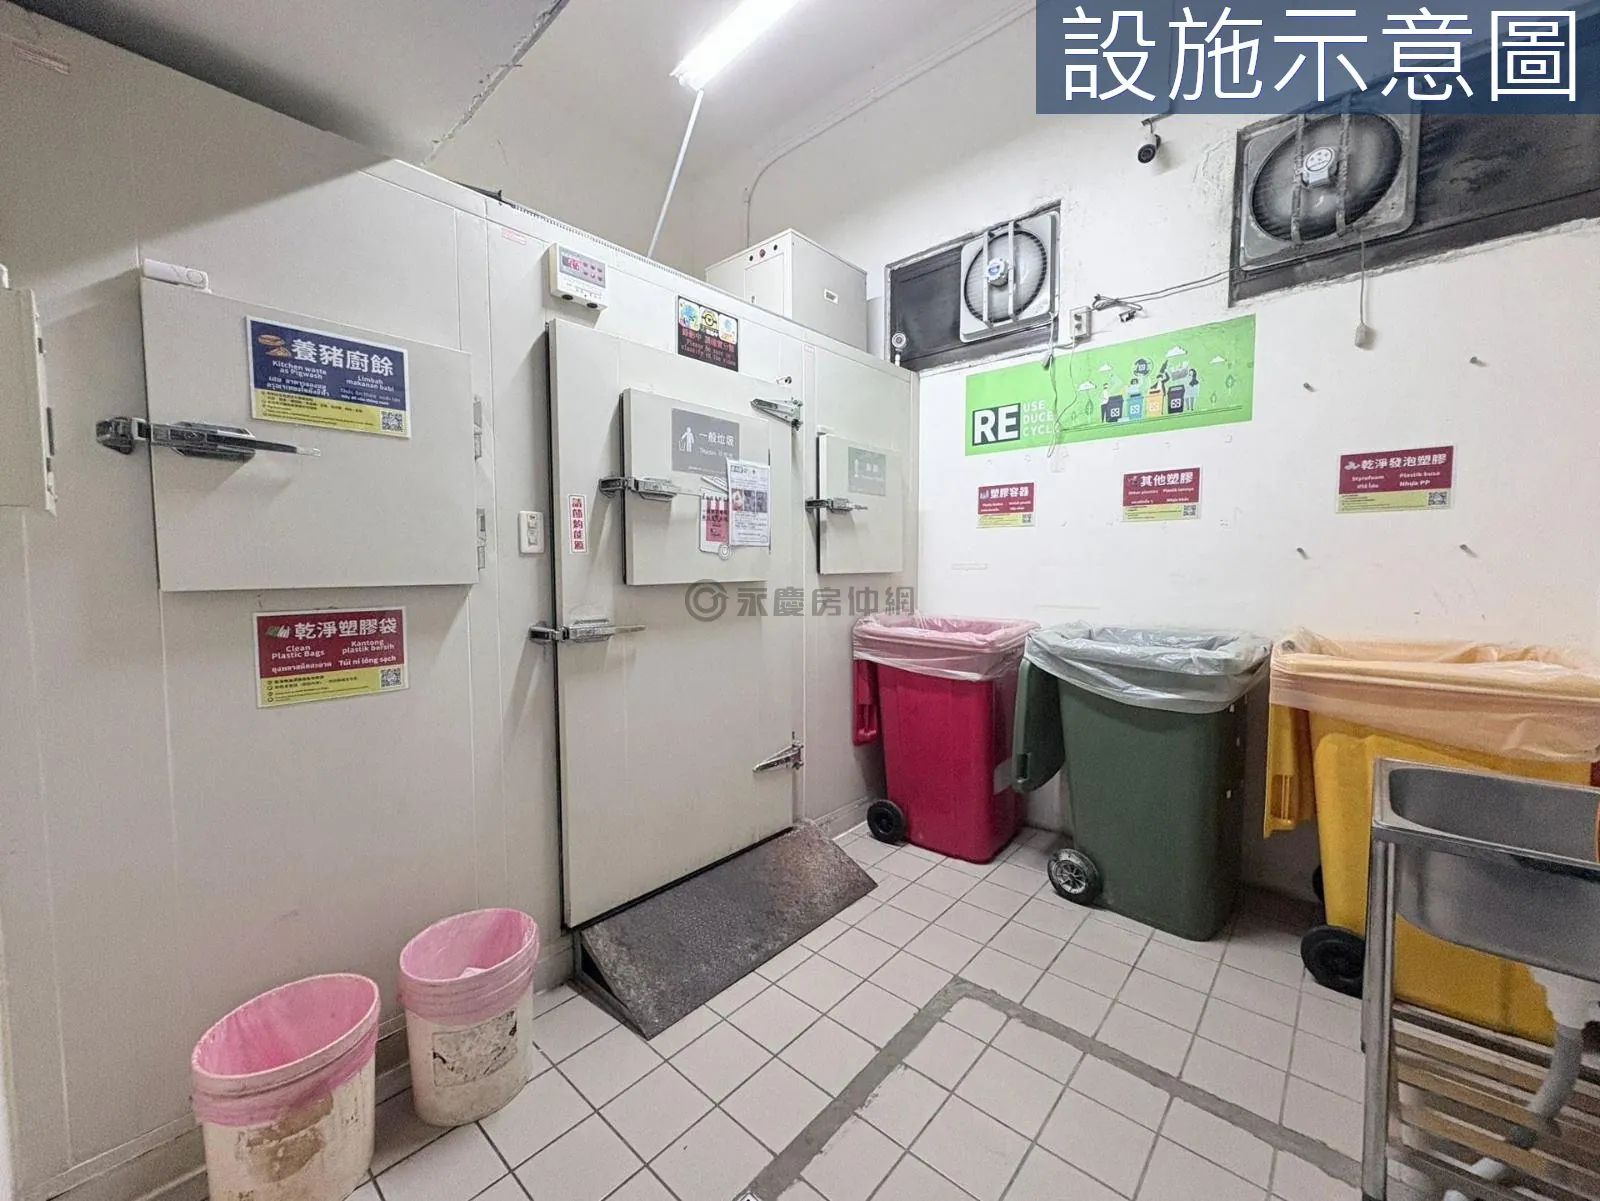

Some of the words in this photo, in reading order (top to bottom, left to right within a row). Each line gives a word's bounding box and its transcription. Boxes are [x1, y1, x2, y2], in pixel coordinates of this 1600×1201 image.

[291, 338, 394, 377] 養豬廚餘
[272, 360, 304, 371] Kitchen
[304, 366, 327, 375] waste
[290, 369, 323, 380] Pigwash
[357, 375, 384, 385] Limbah
[974, 404, 1019, 444] RE
[1023, 400, 1045, 412] USE
[1023, 410, 1054, 424] DUCE
[699, 431, 735, 447] 一般垃圾
[1361, 453, 1447, 470] 乾淨發泡塑膠
[1140, 471, 1193, 487] 其他塑膠
[294, 617, 397, 640] 乾淨塑膠袋
[285, 644, 311, 653] Clean
[342, 645, 369, 655] plastik
[370, 643, 395, 651] bersih
[351, 639, 384, 648] Kantong
[271, 651, 302, 660] Plastic
[304, 649, 325, 659] Bags
